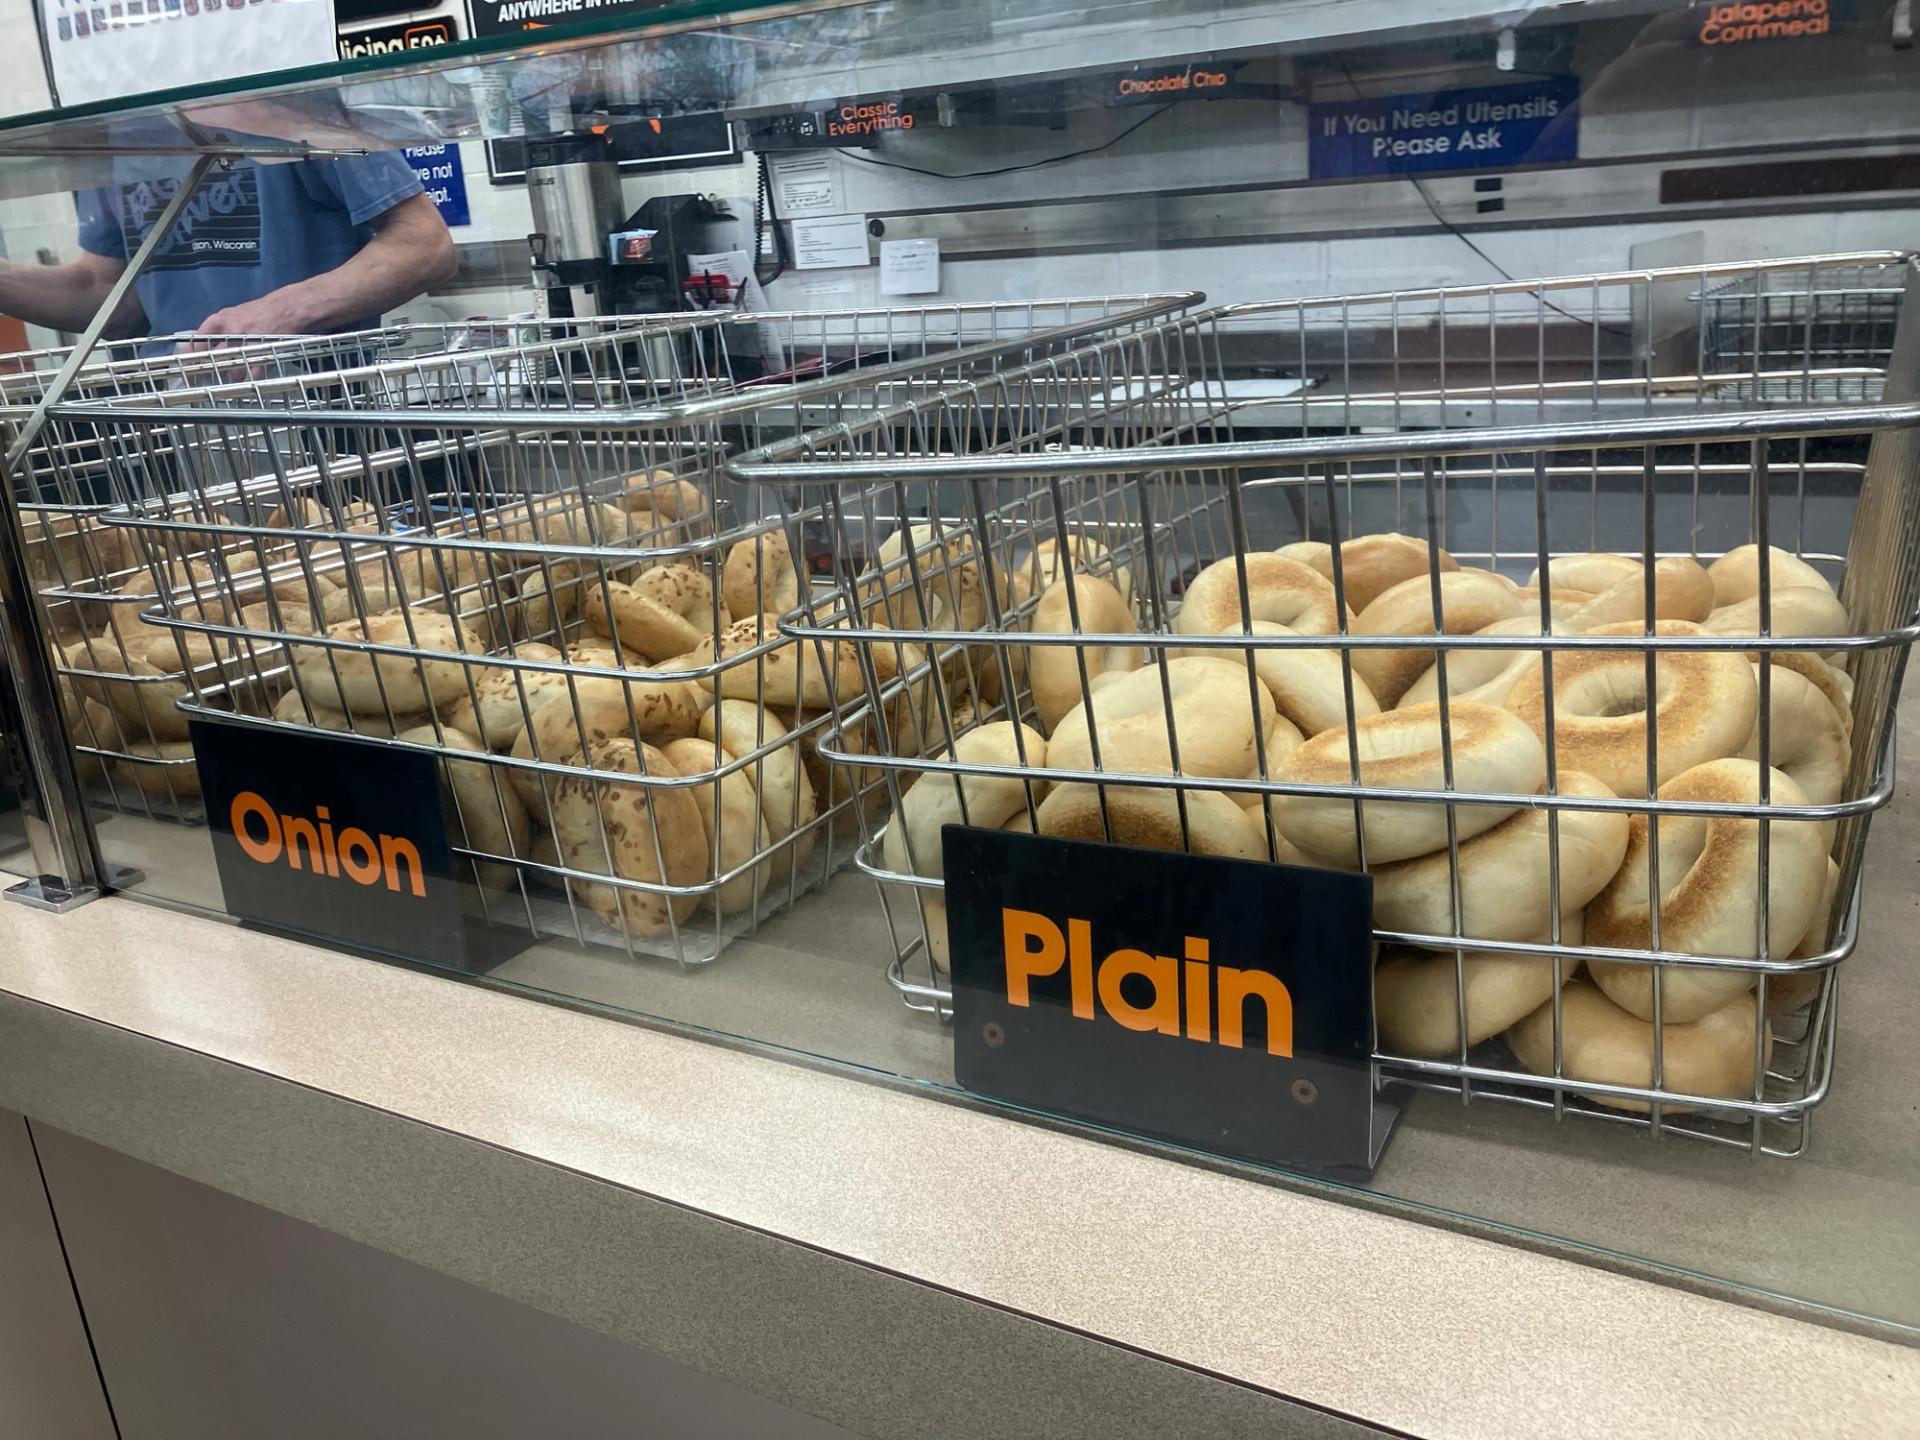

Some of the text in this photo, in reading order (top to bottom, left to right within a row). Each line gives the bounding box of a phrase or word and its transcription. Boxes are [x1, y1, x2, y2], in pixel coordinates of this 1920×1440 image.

[498, 0, 583, 22] ANYWHERE
[340, 36, 404, 59] licing
[1119, 74, 1190, 95] Chocolate
[841, 102, 898, 121] Classic
[1324, 95, 1559, 136] If You Need Utensils
[828, 114, 914, 136] Everything
[1372, 126, 1502, 158] Please Ask
[432, 161, 453, 179] not
[212, 240, 257, 250] Wisconsin
[230, 790, 426, 898] Onion
[1002, 907, 1293, 1058] Plain
